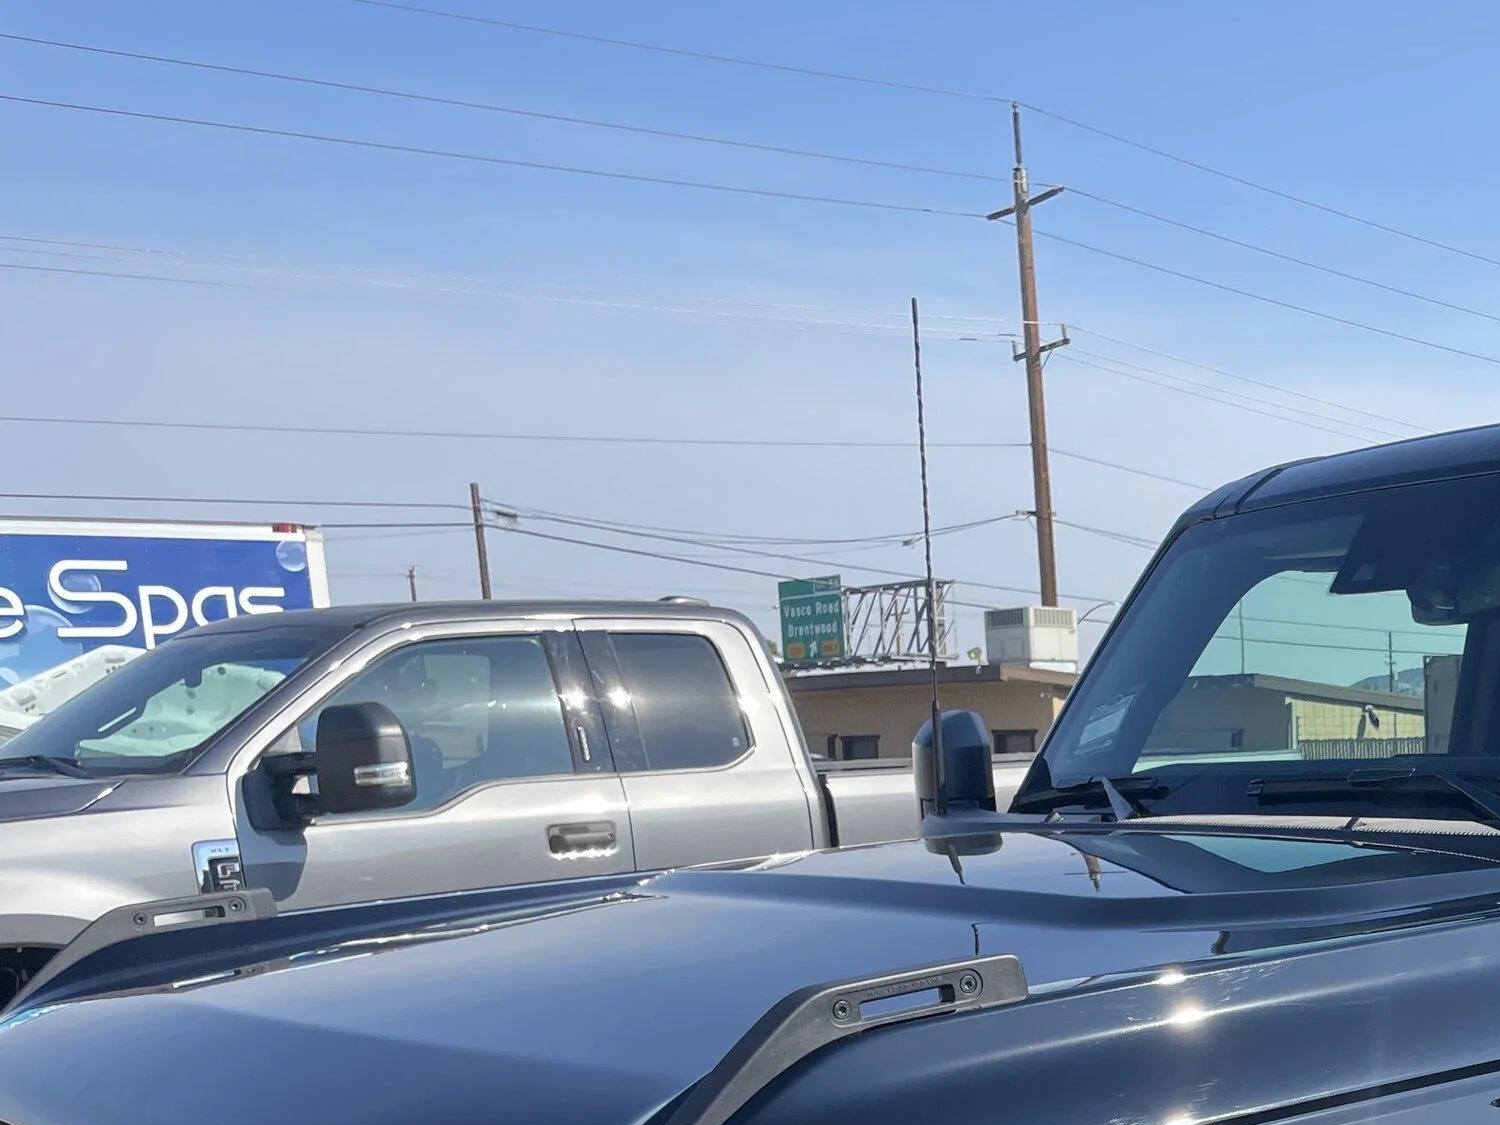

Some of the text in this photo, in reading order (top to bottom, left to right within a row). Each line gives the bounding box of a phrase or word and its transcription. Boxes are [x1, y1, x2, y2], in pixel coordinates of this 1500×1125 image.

[49, 559, 285, 650] Spas
[783, 601, 839, 618] Vasco Road
[788, 620, 838, 638] Brentwood
